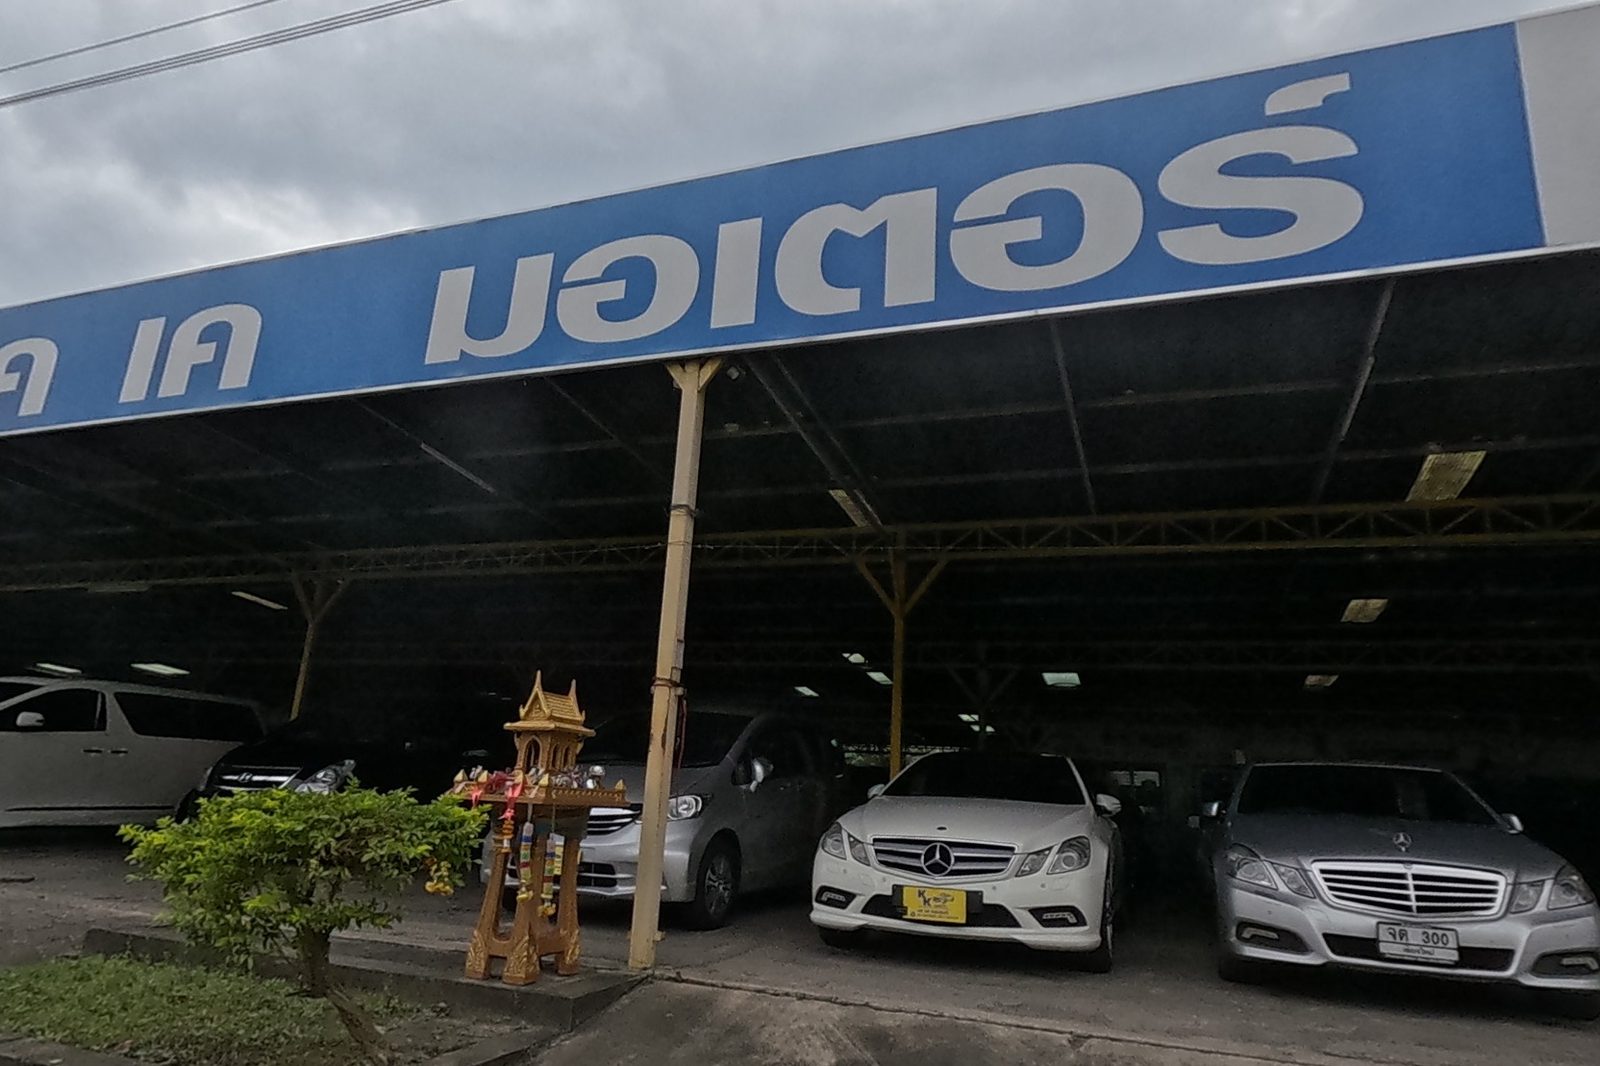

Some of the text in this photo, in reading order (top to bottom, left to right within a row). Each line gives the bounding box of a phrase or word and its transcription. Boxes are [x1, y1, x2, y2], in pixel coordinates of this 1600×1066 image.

[119, 303, 263, 403] เค
[424, 72, 1364, 365] มอเตอร์
[1422, 931, 1449, 946] 300
